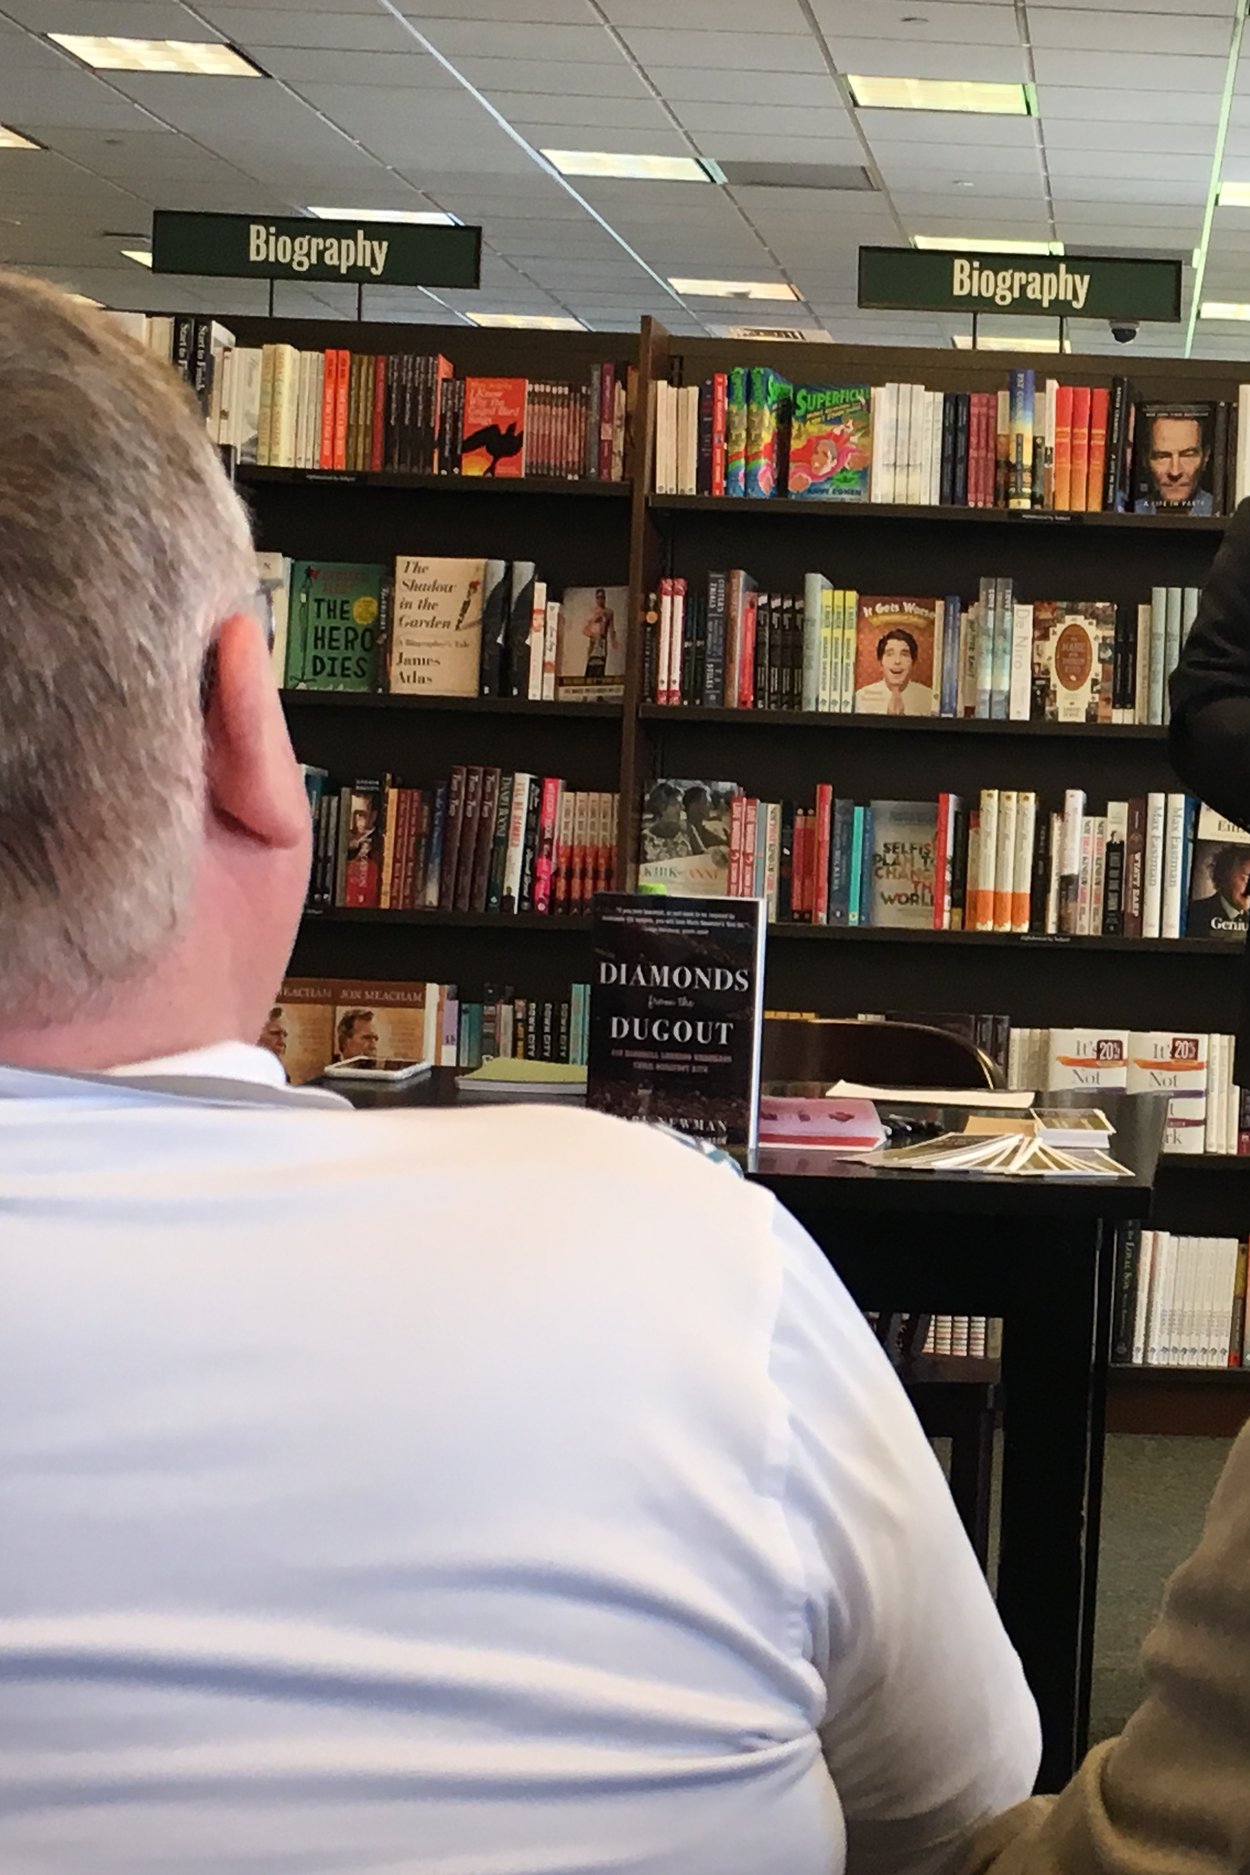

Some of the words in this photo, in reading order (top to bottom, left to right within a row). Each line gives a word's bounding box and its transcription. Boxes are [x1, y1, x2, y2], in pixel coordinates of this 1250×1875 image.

[250, 224, 388, 275] Biography
[953, 259, 1090, 310] Biography
[404, 561, 429, 574] The
[402, 579, 456, 593] Shadow
[314, 598, 350, 620] THE
[400, 597, 413, 610] in
[417, 596, 439, 610] the
[862, 606, 873, 617] It
[874, 602, 900, 614] Gets
[398, 614, 452, 629] Garden
[1016, 608, 1029, 630] De
[314, 626, 374, 652] HERO
[396, 652, 441, 666] James
[1014, 635, 1028, 670] Niro
[312, 655, 368, 678] DIES
[399, 670, 433, 684] Atlas
[1151, 806, 1162, 832] Max
[1172, 807, 1182, 832] Max
[882, 842, 932, 854] SELFIS
[1148, 834, 1162, 886] Eastman
[1168, 836, 1182, 888] Eastman
[912, 880, 932, 894] TH
[1210, 916, 1249, 932] Geniu
[600, 962, 749, 992] DIAMONDS
[281, 986, 332, 998] EACHAM
[340, 988, 361, 1000] JON
[364, 990, 422, 1002] MEACHAM
[648, 994, 676, 1009] from
[678, 996, 694, 1008] the
[528, 1002, 536, 1032] DOWN
[544, 1002, 552, 1033] DOWN
[610, 1016, 733, 1044] DUGOUT
[544, 1034, 552, 1057] CITY
[1153, 1042, 1172, 1060] It'
[1072, 1068, 1100, 1086] Not
[1150, 1070, 1178, 1088] Not
[1165, 1128, 1182, 1144] rk
